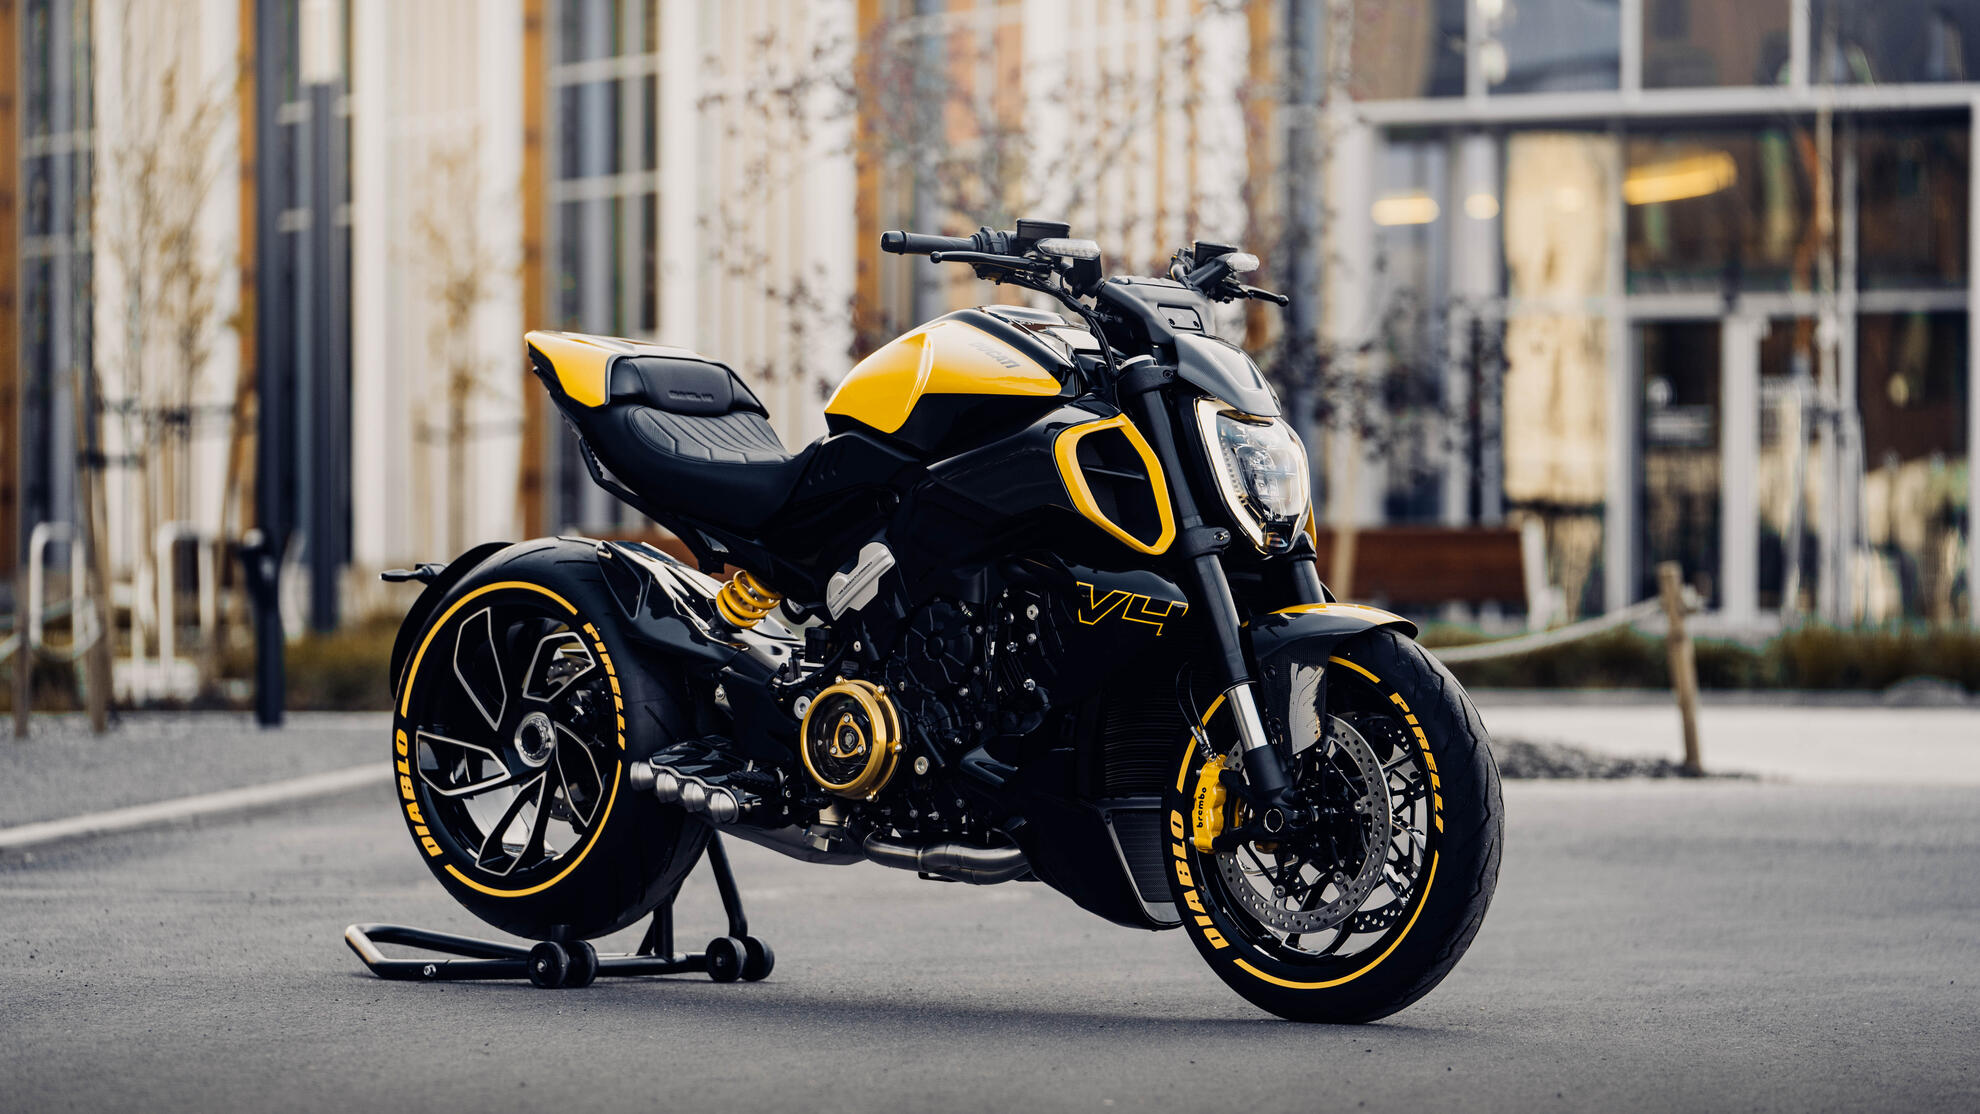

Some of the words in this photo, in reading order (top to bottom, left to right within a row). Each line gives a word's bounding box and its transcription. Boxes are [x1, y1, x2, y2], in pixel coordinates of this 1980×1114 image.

[967, 342, 1022, 369] DUCATI
[1076, 580, 1189, 637] V4
[582, 621, 626, 751] PIRELLI
[395, 728, 444, 858] DIABLO
[1196, 786, 1207, 828] brembo
[1389, 691, 1445, 834] PIRELLI
[1170, 809, 1230, 950] DIABLO
